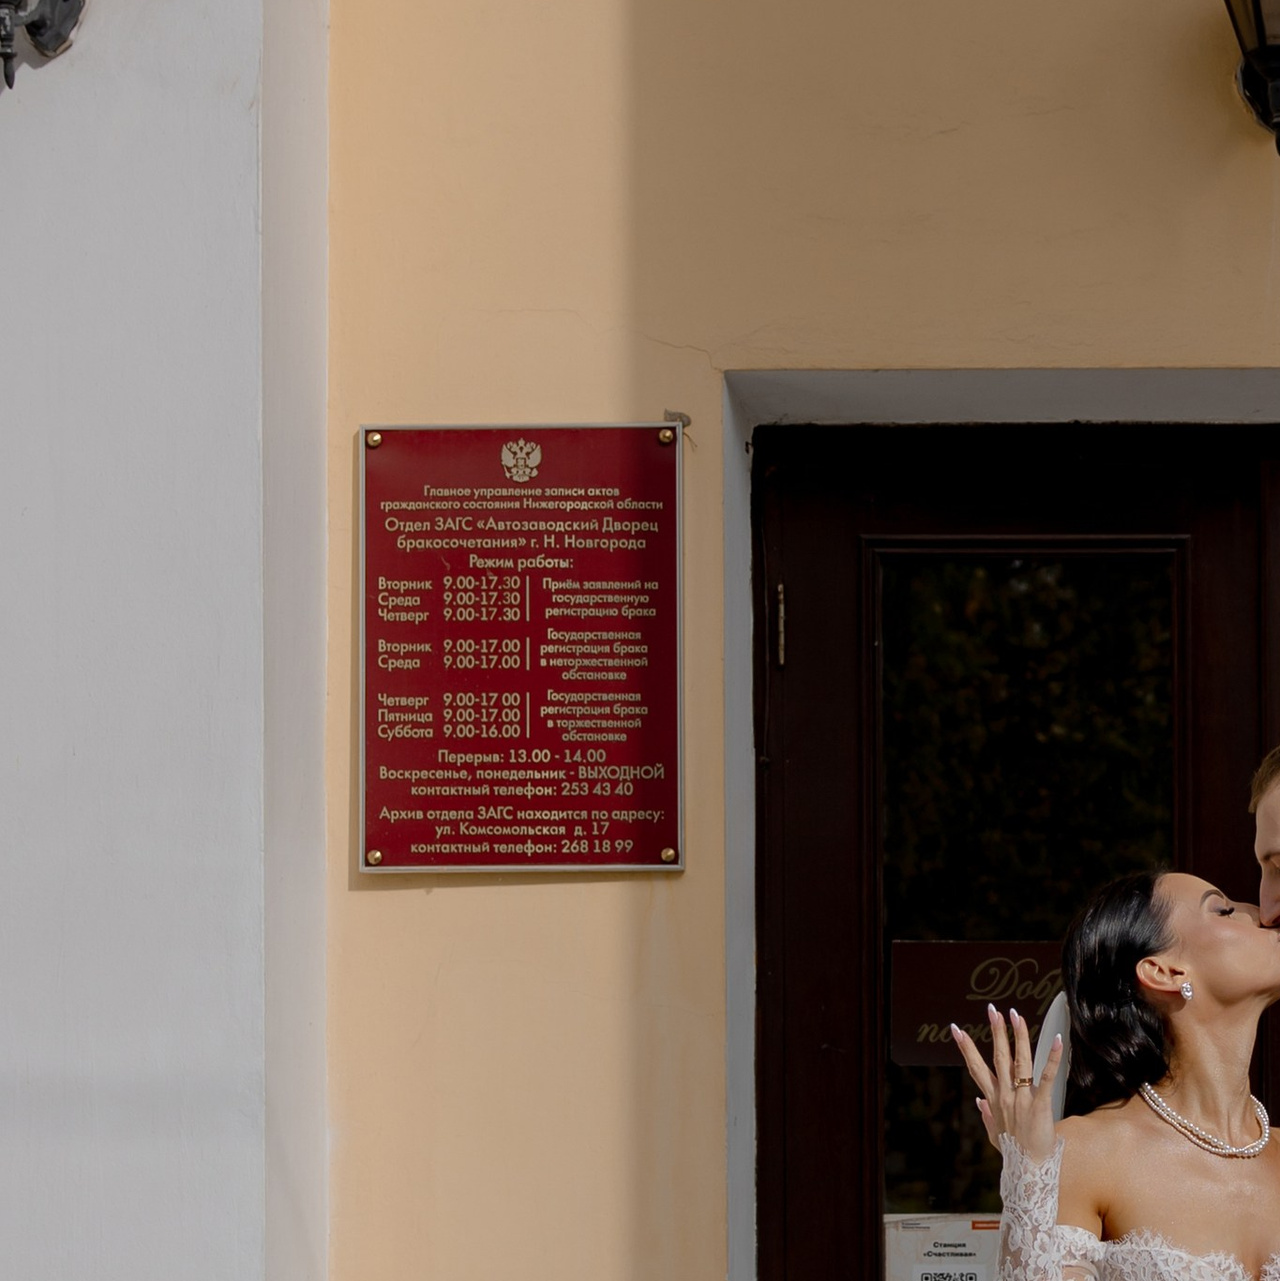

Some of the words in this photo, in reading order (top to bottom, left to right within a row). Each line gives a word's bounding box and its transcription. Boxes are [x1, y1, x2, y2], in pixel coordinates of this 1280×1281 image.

[423, 484, 472, 498] Главное
[472, 486, 542, 499] управление
[543, 486, 585, 498] записи
[586, 486, 620, 497] актов
[380, 498, 461, 512] гражданского
[462, 499, 521, 510] состояния
[522, 497, 615, 513] Нижегородской
[616, 498, 664, 511] области
[384, 517, 431, 533] Отдел
[433, 517, 474, 532] ЗАГС
[476, 517, 599, 533] «Автозаводский
[601, 517, 659, 535] Дворец
[396, 534, 527, 552] бракосочетания»
[530, 538, 540, 549] г.
[543, 534, 560, 549] Н.
[563, 534, 647, 552] Новгорода
[469, 554, 515, 569] Режим
[517, 554, 574, 572] работы:
[377, 576, 433, 594] Вторник
[443, 576, 521, 591] 9.00-17.30
[542, 577, 581, 592] Приём
[582, 578, 642, 591] заявлений
[643, 579, 659, 591] на
[377, 593, 421, 610] Среда
[443, 591, 521, 607] 9.00-17.30
[551, 593, 650, 605] государственную
[377, 608, 430, 625] Четверг
[443, 607, 521, 622] 9.00-17.30
[545, 607, 619, 619] регистрацию
[620, 605, 657, 619] брака
[546, 628, 642, 643] Государственная
[377, 639, 433, 657] Вторник
[443, 639, 521, 654] 9.00-17.00
[539, 643, 612, 656] регистрация
[612, 642, 649, 656] брака
[377, 656, 421, 672] Среда
[443, 655, 521, 670] 9.00-17.00
[539, 657, 548, 667] в
[548, 656, 649, 669] неторжественной
[561, 669, 627, 681] обстановке
[377, 694, 430, 710] Четверг
[546, 689, 642, 704] Государственная
[377, 710, 433, 726] Пятница
[443, 708, 521, 723] 9.00-17.00
[539, 705, 612, 718] регистрация
[612, 704, 649, 717] брака
[546, 719, 555, 728] в
[556, 717, 642, 731] торжественной
[377, 725, 434, 742] Суббота
[443, 724, 521, 739] 9.00-16.00
[561, 730, 628, 743] обстановке
[437, 749, 505, 767] Перерыв:
[509, 749, 551, 764] 13.00
[563, 749, 606, 764] 14.00
[379, 766, 473, 783] Воскресенье,
[475, 767, 567, 781] понедельник
[577, 762, 666, 782] ВЫХОДНОЙ
[410, 783, 491, 797] контактный
[492, 782, 558, 800] телефон:
[560, 782, 589, 797] 253
[592, 782, 612, 797] 43
[613, 782, 634, 797] 40
[378, 806, 424, 823] Архив
[426, 807, 475, 822] отдела
[477, 806, 514, 820] ЗАГС
[516, 809, 589, 821] находится
[590, 809, 608, 820] по
[610, 809, 666, 823] адресу:
[434, 824, 456, 839] ул.
[459, 821, 567, 836] Комсомольская
[573, 824, 588, 838] д.
[591, 821, 610, 836] 17
[410, 841, 491, 854] контактный
[492, 840, 558, 857] телефон:
[560, 840, 590, 854] 268
[592, 840, 612, 854] 18
[613, 840, 634, 854] 99
